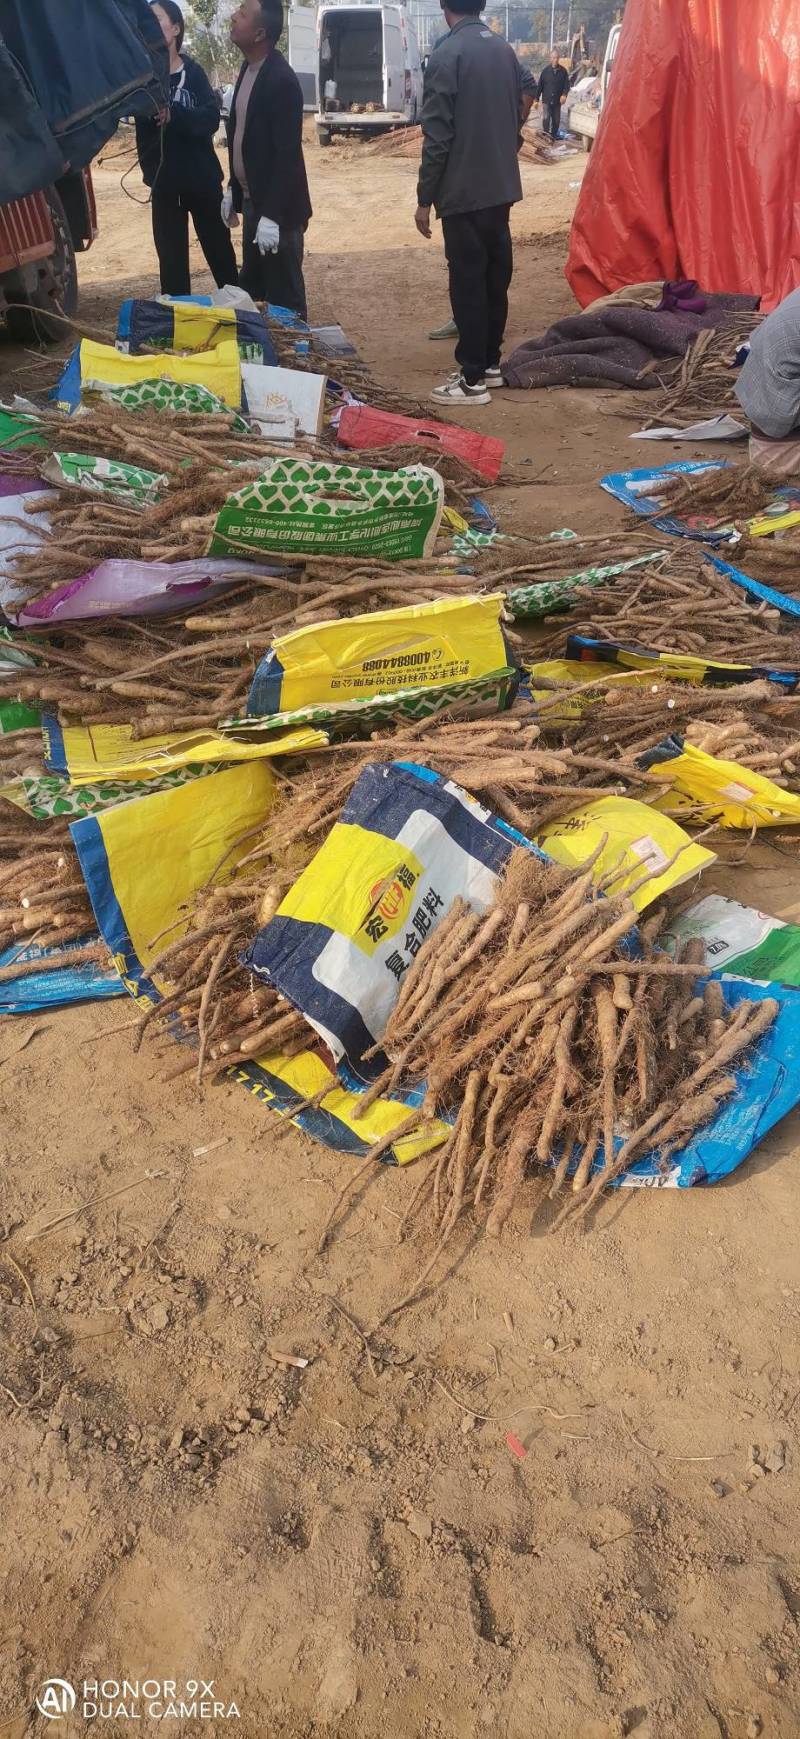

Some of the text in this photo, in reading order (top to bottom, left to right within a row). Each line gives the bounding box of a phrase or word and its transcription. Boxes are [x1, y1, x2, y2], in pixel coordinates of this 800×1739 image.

[362, 652, 431, 672] 4008844088
[331, 665, 469, 688] 新洋丰农业科技股份有限公司
[385, 886, 444, 981] 复合肥料
[251, 1083, 276, 1103] 17
